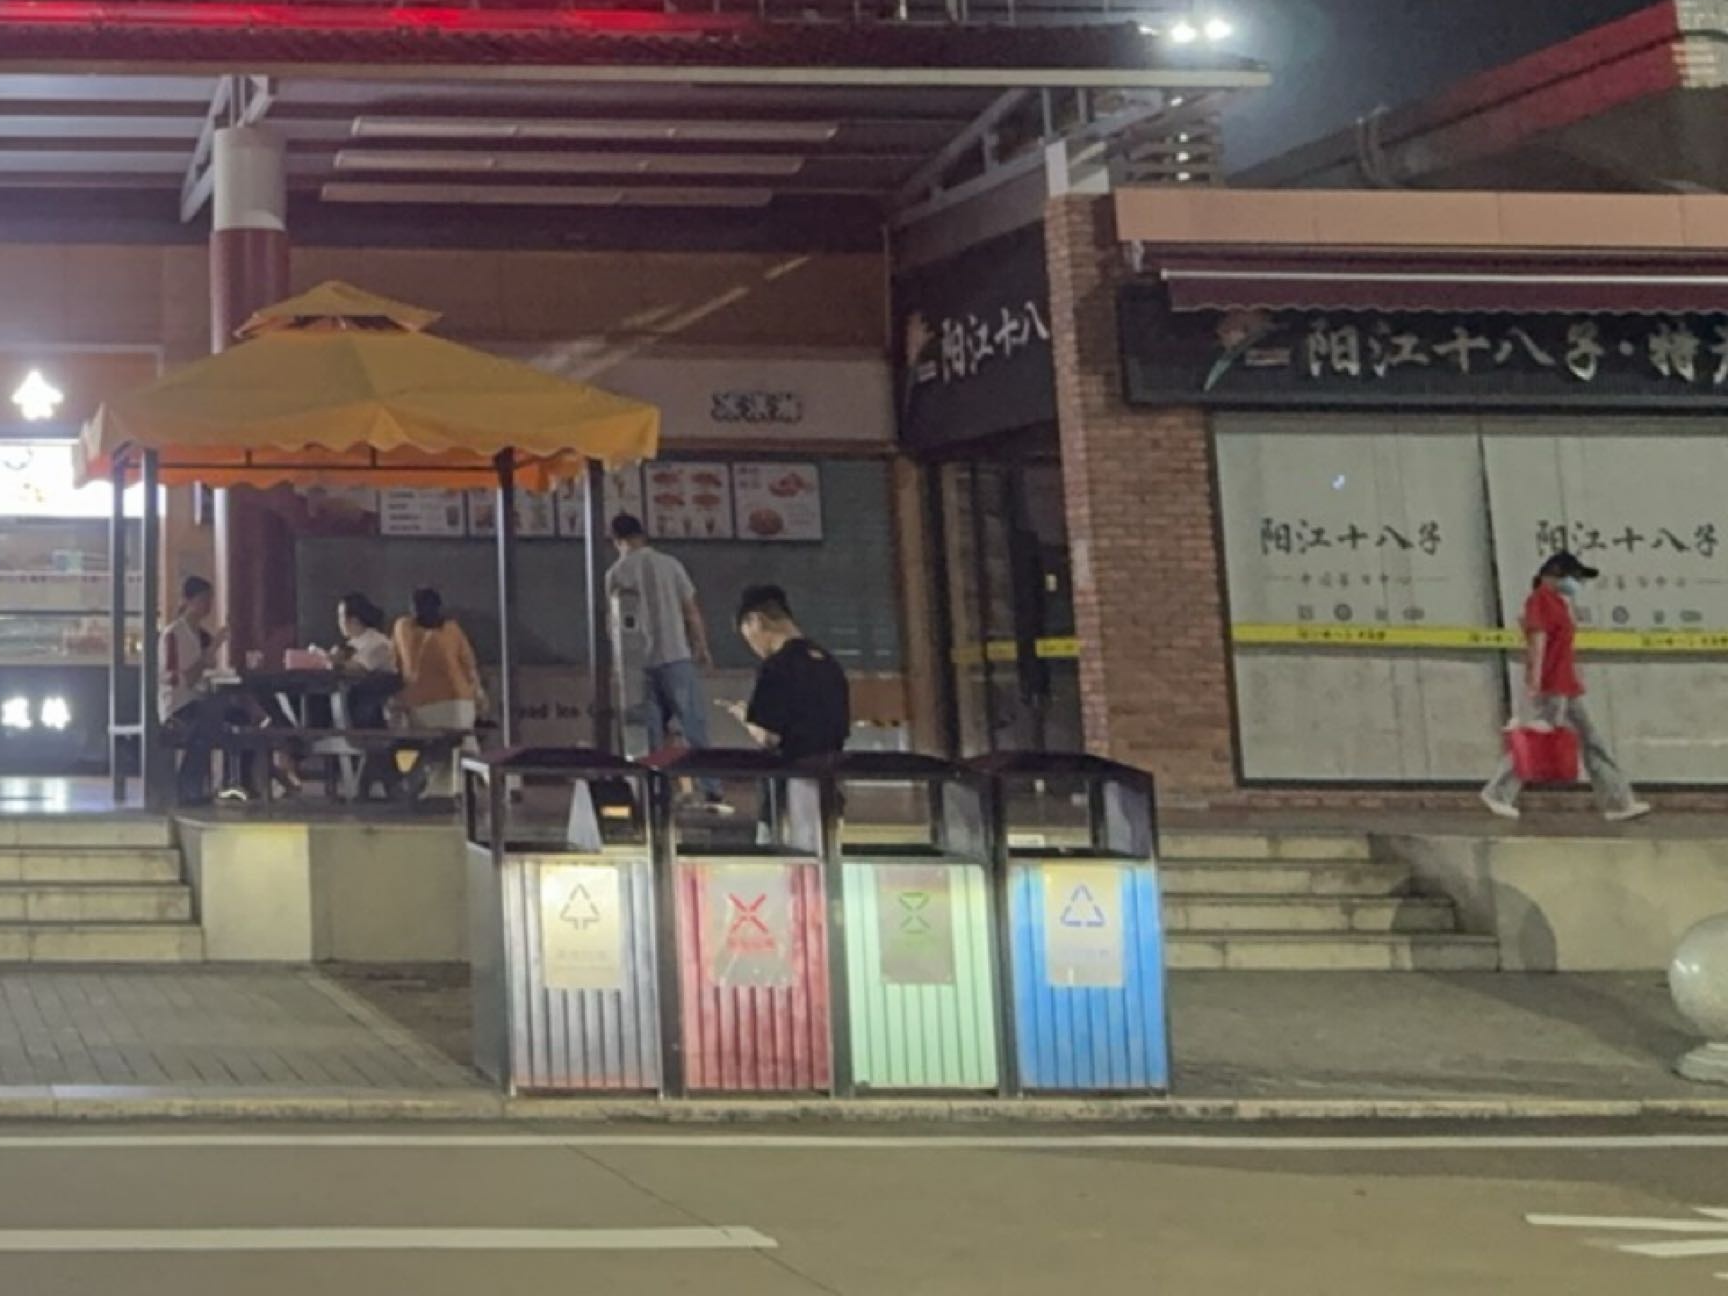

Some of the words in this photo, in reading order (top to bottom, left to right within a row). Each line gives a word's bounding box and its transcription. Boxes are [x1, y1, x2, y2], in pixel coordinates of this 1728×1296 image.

[1260, 516, 1442, 556] 阳江十八子
